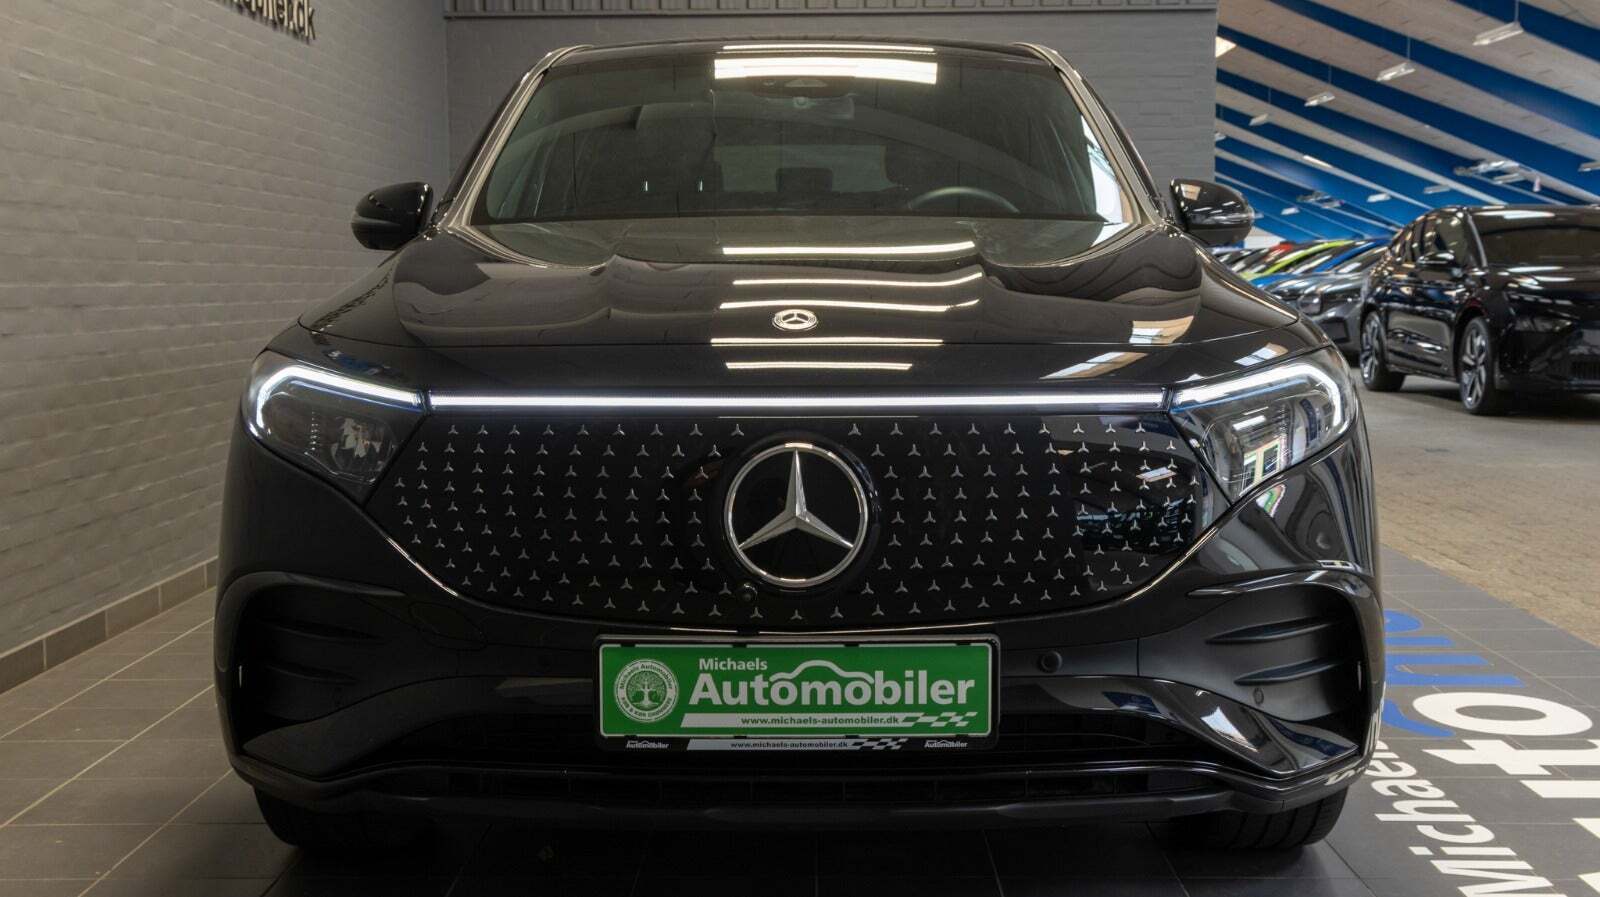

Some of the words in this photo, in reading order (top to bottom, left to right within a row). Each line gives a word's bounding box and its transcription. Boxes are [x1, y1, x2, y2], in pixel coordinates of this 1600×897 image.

[699, 658, 768, 671] Michaels
[688, 670, 975, 705] Automobiler
[741, 716, 899, 726] www.michaels-automobiler.dk
